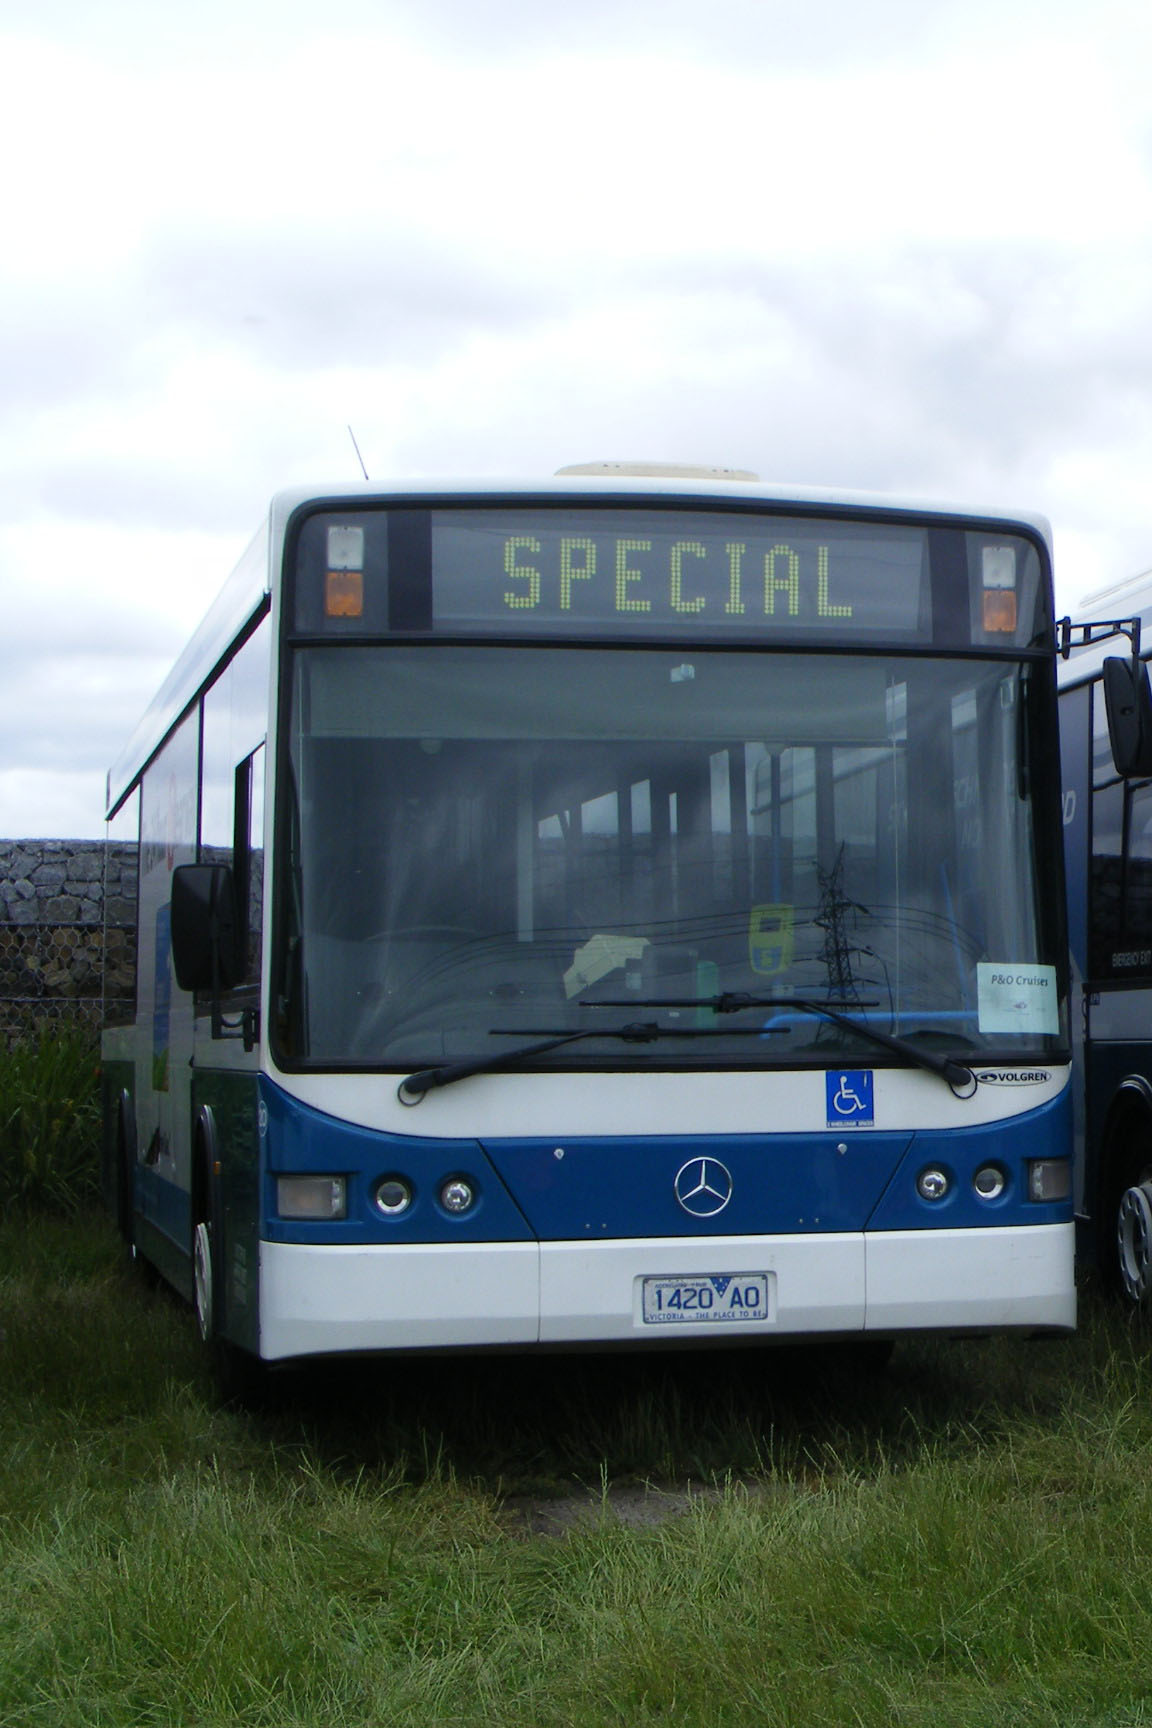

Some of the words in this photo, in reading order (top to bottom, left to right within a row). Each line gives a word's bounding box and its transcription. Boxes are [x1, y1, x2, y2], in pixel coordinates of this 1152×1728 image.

[503, 535, 853, 618] SPECIAL
[991, 974, 1014, 985] P&O
[1015, 975, 1049, 987] Cruises
[998, 1072, 1048, 1082] VOLGREN
[655, 1287, 714, 1311] 1420
[649, 1312, 686, 1321] VICTORIA
[695, 1311, 710, 1319] THE
[713, 1310, 736, 1319] PLACE
[739, 1310, 750, 1318] TO
[752, 1309, 763, 1317] BE
